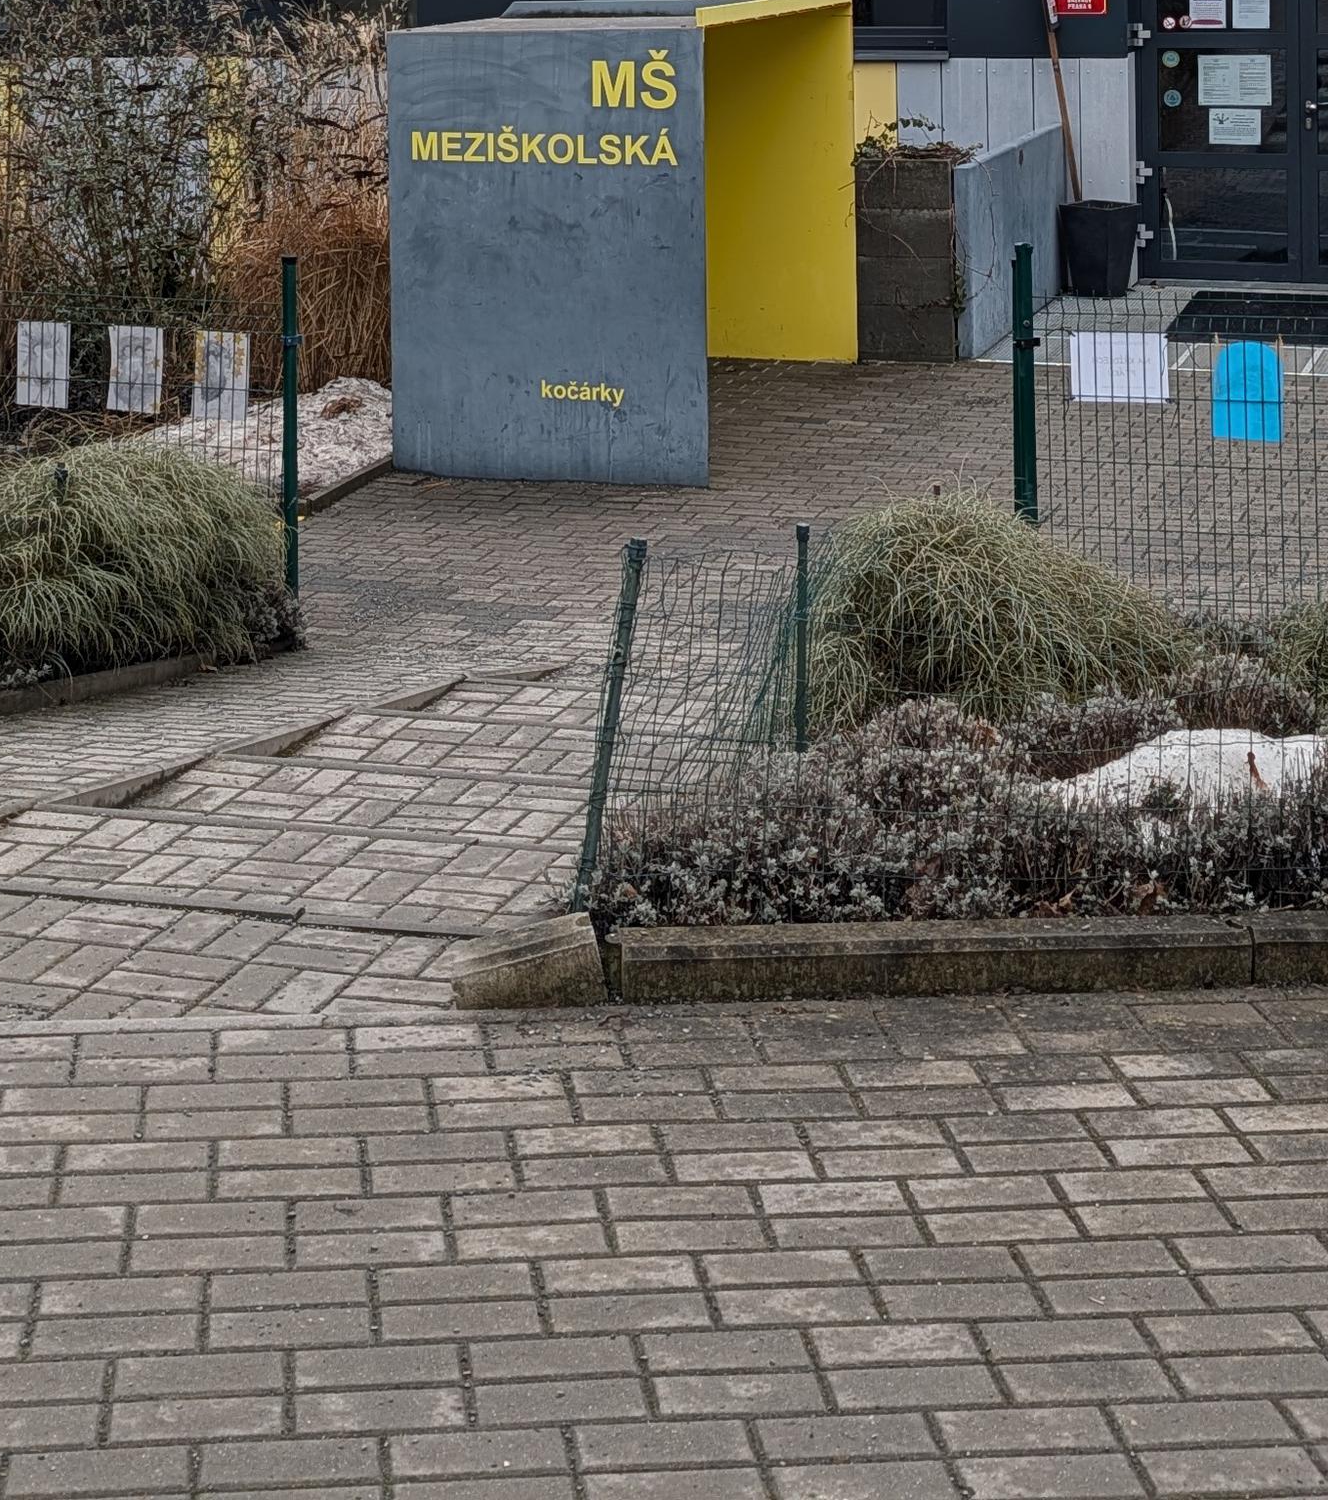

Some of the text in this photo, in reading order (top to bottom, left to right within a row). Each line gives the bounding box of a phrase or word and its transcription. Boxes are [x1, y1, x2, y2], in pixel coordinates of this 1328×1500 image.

[591, 49, 678, 110] MŠ
[411, 126, 678, 168] MEZIŠKOLSKÁ
[540, 379, 625, 408] kočárky
